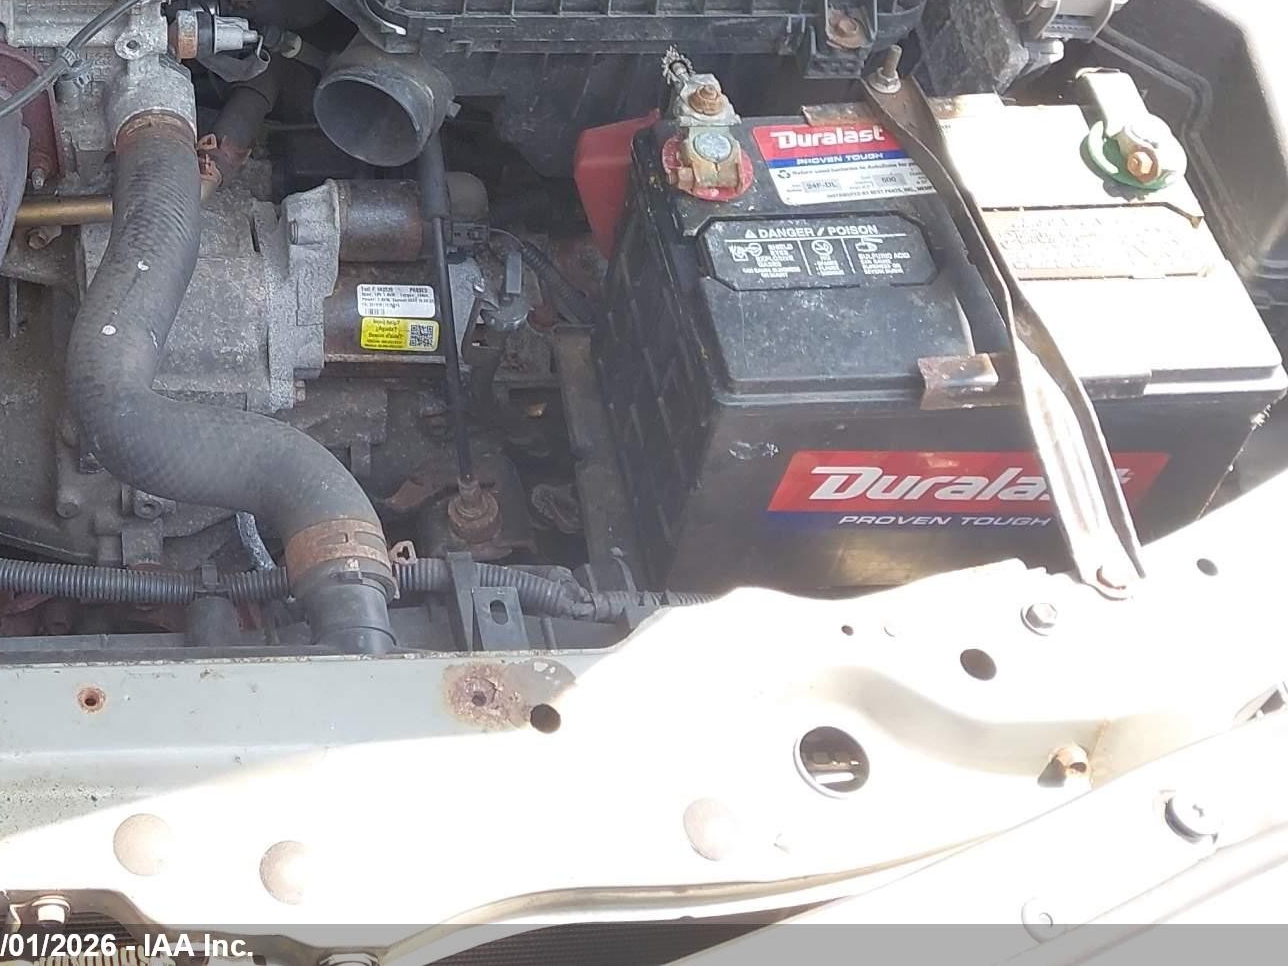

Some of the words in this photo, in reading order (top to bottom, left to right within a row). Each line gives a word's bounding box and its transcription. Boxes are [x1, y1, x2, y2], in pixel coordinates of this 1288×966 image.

[770, 125, 886, 150] Duralast
[796, 154, 843, 166] PROVEN
[846, 152, 884, 163] TOUGH
[759, 228, 815, 238] DANGER
[827, 224, 878, 236] POISON
[809, 466, 1134, 501] Durala
[838, 514, 952, 526] PROVEN
[961, 515, 1051, 527] TOUGH
